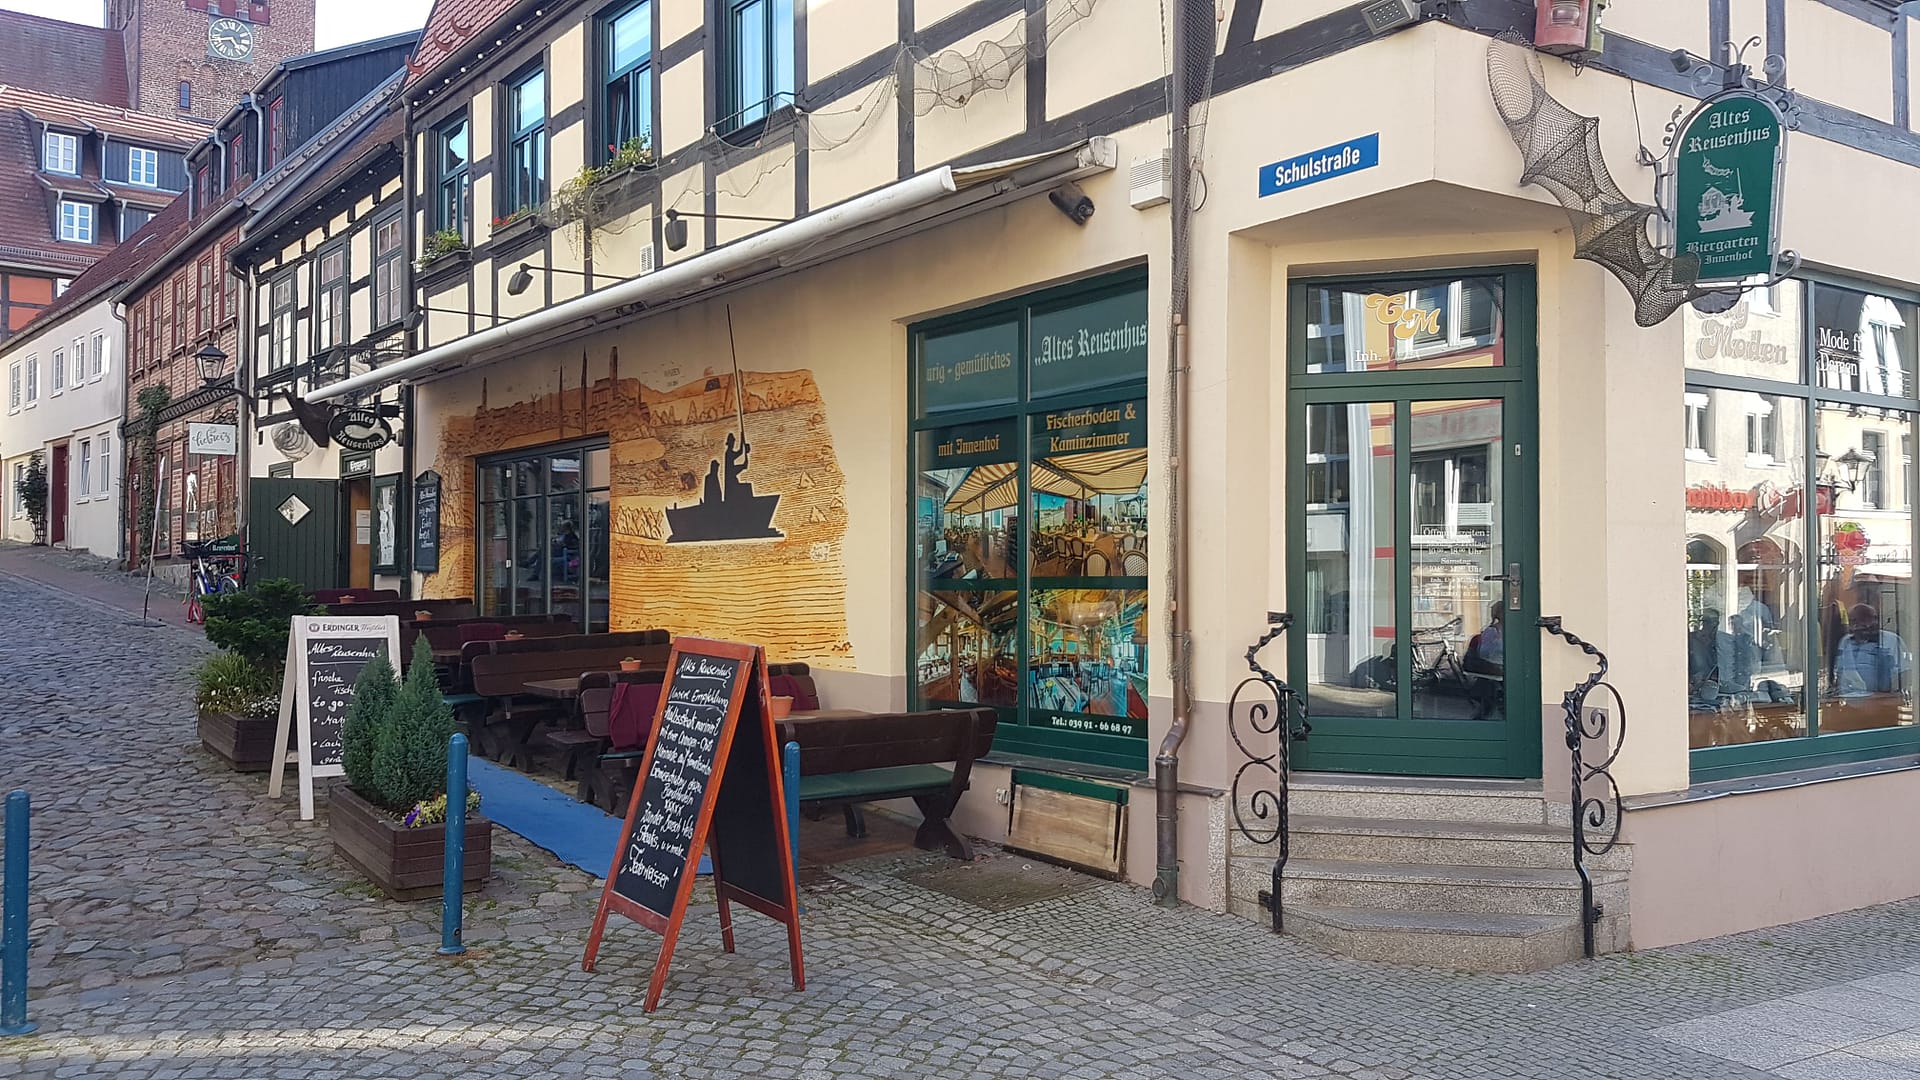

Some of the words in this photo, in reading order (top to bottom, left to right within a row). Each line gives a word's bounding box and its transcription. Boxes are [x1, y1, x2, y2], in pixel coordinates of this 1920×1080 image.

[1708, 108, 1751, 131] Altes
[1688, 125, 1771, 153] Reusenhus
[1275, 146, 1360, 187] Schulstraße
[1686, 237, 1758, 253] Biergarten
[1819, 327, 1850, 351] Mode
[1355, 349, 1382, 361] Inh.
[927, 362, 945, 384] urig
[955, 349, 1011, 381] gemütliches
[1047, 407, 1121, 430] Fischerboden
[1124, 402, 1137, 420] &
[938, 441, 953, 457] mit
[1050, 432, 1130, 452] Kaminzimmer
[322, 623, 360, 632] ERDINGER
[312, 696, 326, 707] to
[1051, 716, 1067, 727] Tel.:
